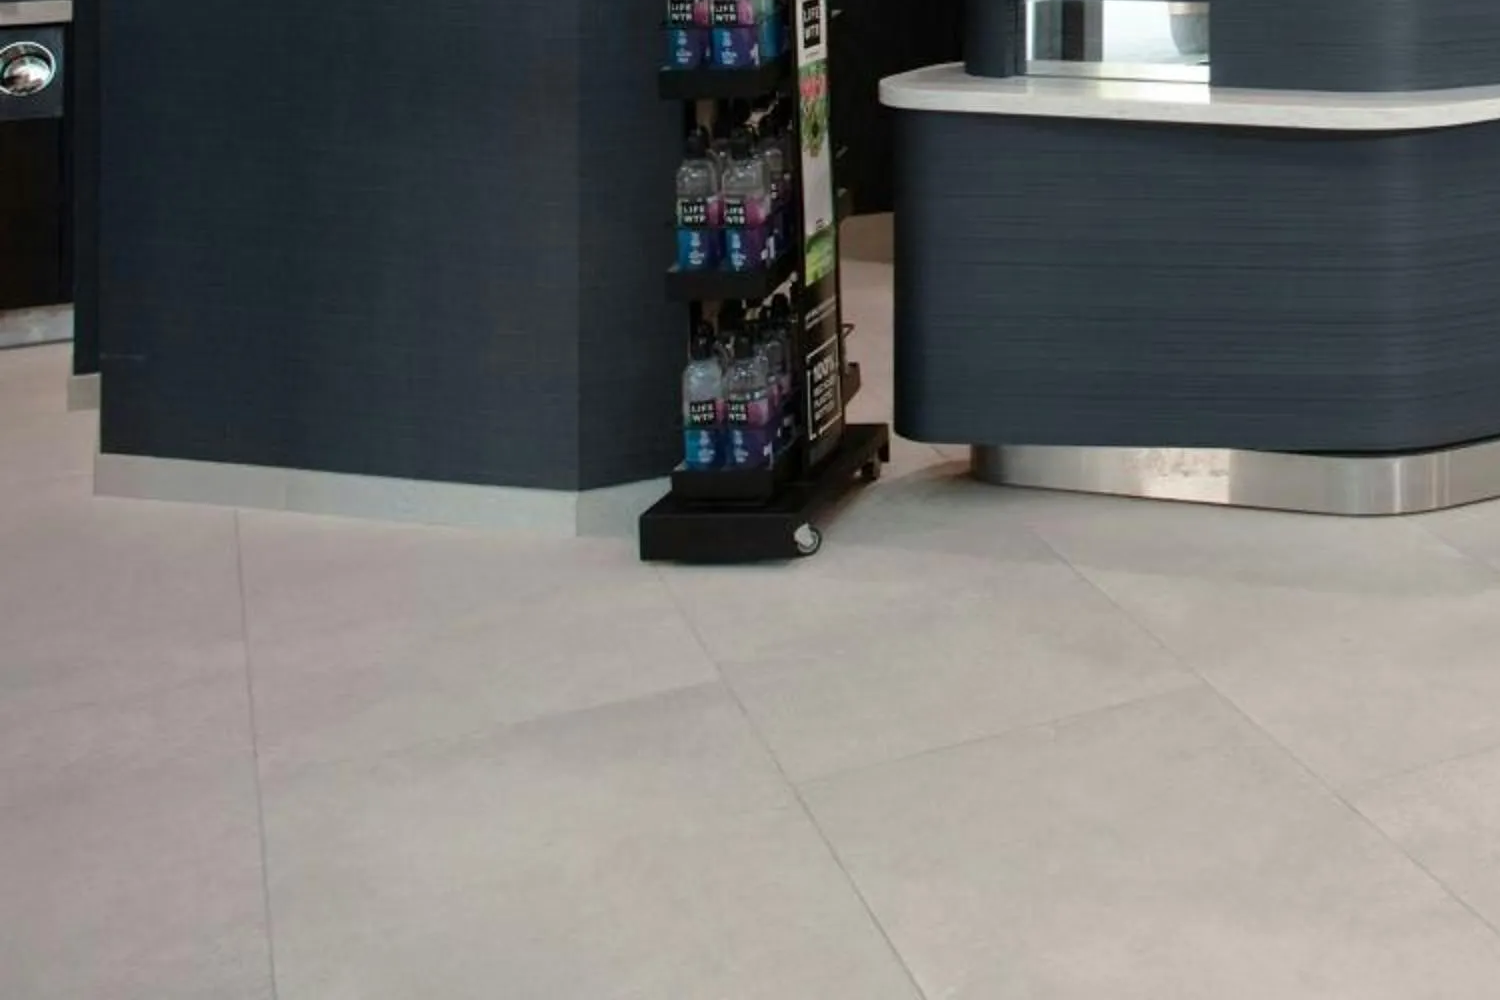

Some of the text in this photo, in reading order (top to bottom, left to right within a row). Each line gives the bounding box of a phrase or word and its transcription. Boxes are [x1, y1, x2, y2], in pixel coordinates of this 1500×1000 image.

[671, 3, 692, 12] LIFE
[671, 13, 693, 22] WTR
[715, 13, 737, 23] WTR
[802, 6, 822, 23] LIFE
[683, 204, 706, 214] LIFE
[690, 403, 715, 412] LIFE
